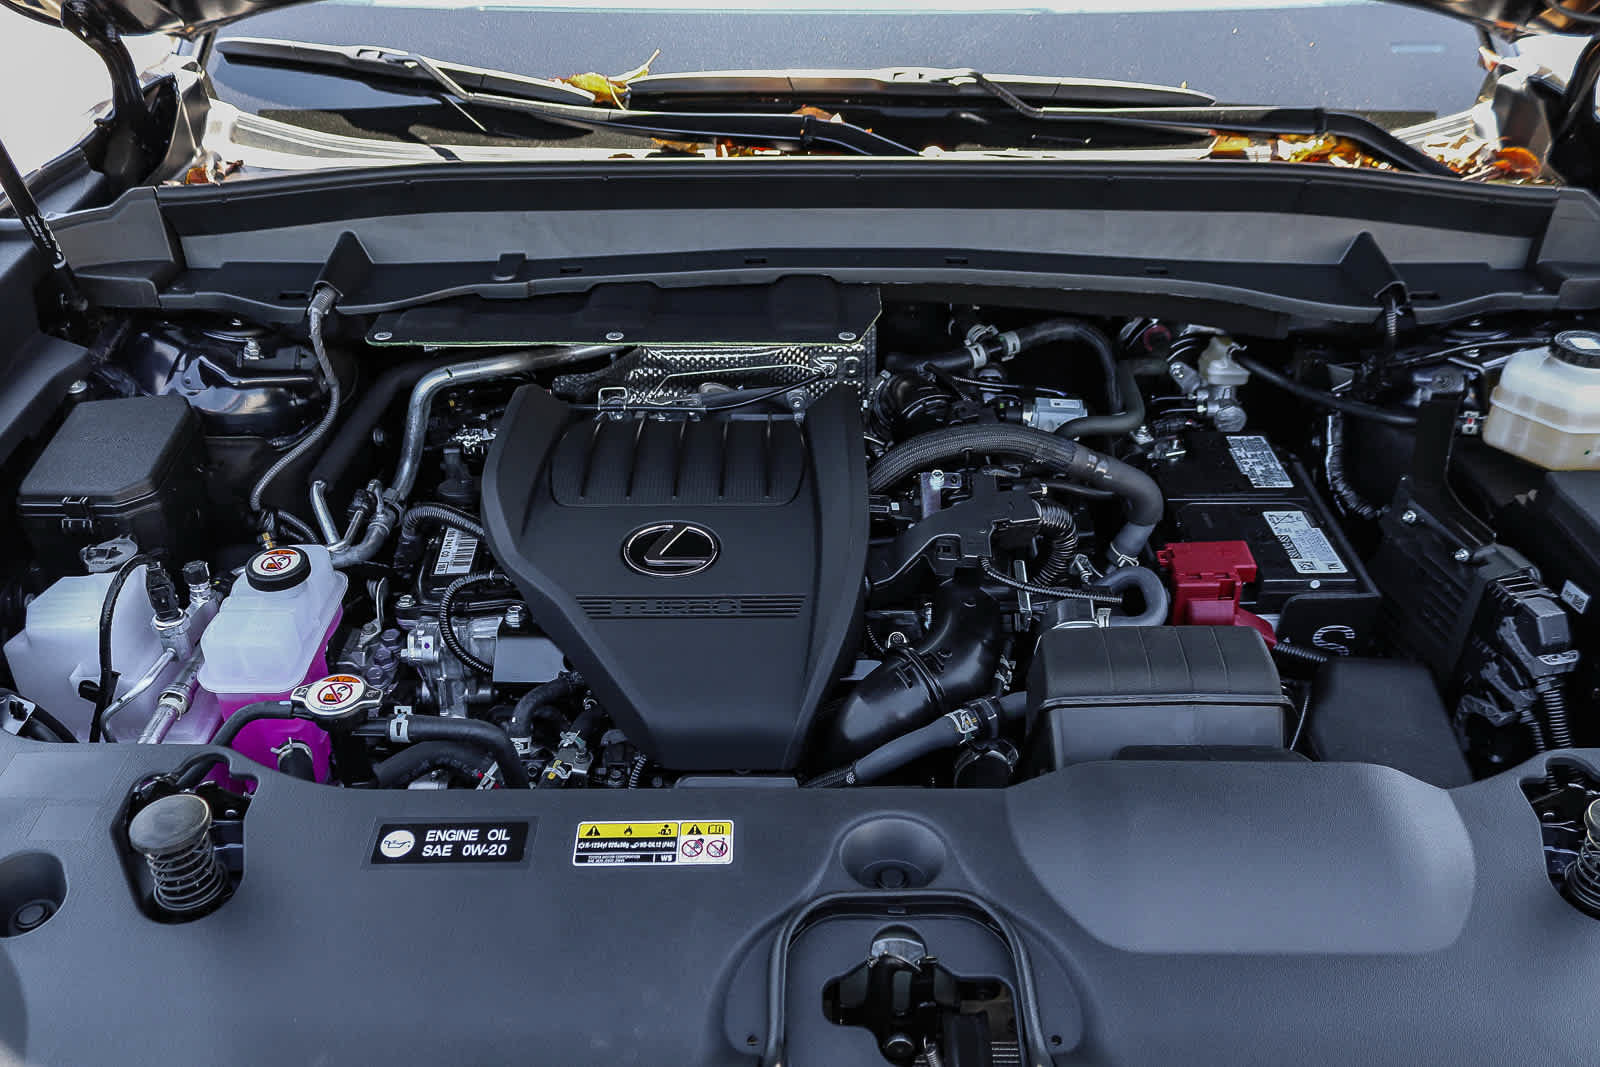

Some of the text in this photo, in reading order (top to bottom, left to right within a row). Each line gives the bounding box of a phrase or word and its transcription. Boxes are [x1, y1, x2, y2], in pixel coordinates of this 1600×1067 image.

[611, 599, 737, 614] TURBO
[425, 828, 511, 842] ENGINE OIL
[422, 844, 507, 857] SAE 0W-20
